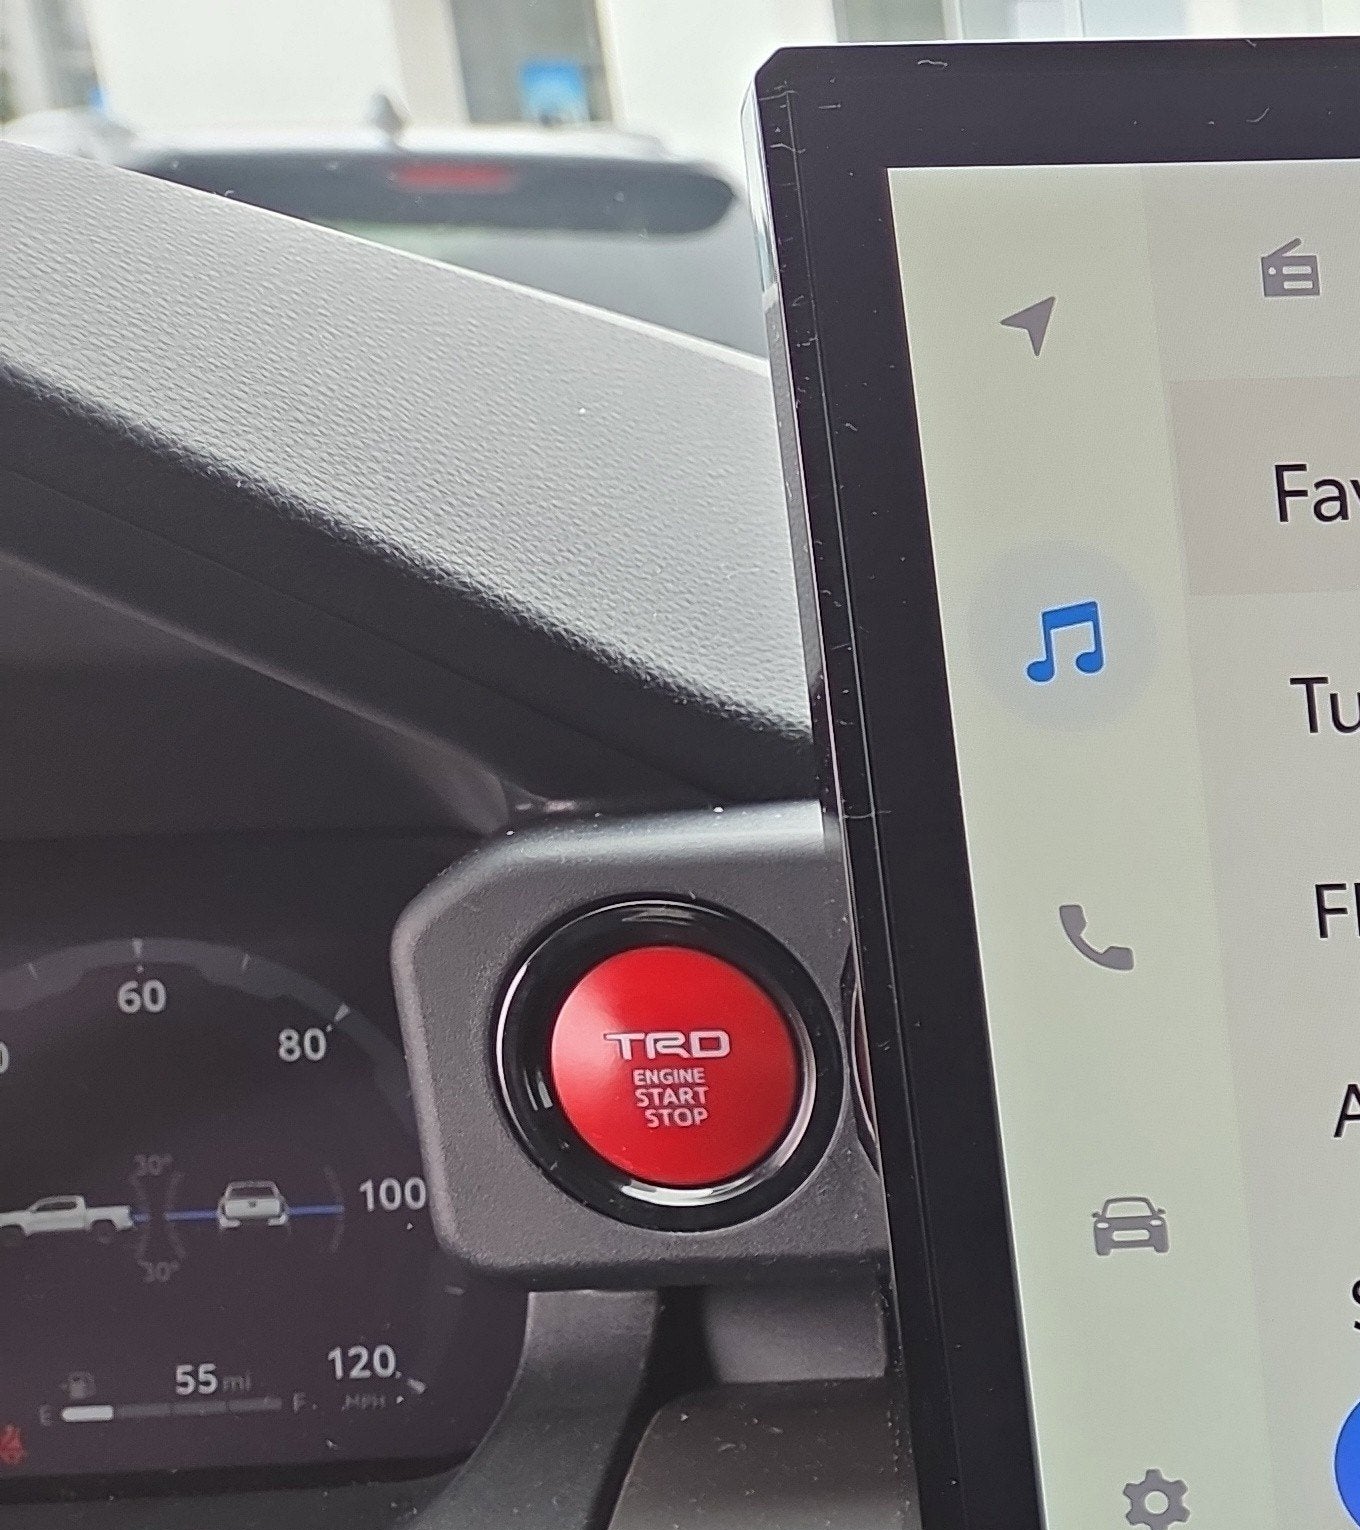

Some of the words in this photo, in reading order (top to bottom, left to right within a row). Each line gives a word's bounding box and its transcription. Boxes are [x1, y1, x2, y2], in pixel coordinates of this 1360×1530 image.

[117, 979, 167, 1014] 60
[278, 1028, 327, 1062] 80
[603, 1030, 730, 1060] TRD
[633, 1068, 706, 1086] ENGINE
[635, 1087, 709, 1107] START
[645, 1108, 708, 1128] STOP
[359, 1176, 427, 1212] 100
[327, 1344, 396, 1380] 120
[175, 1363, 219, 1396] 55
